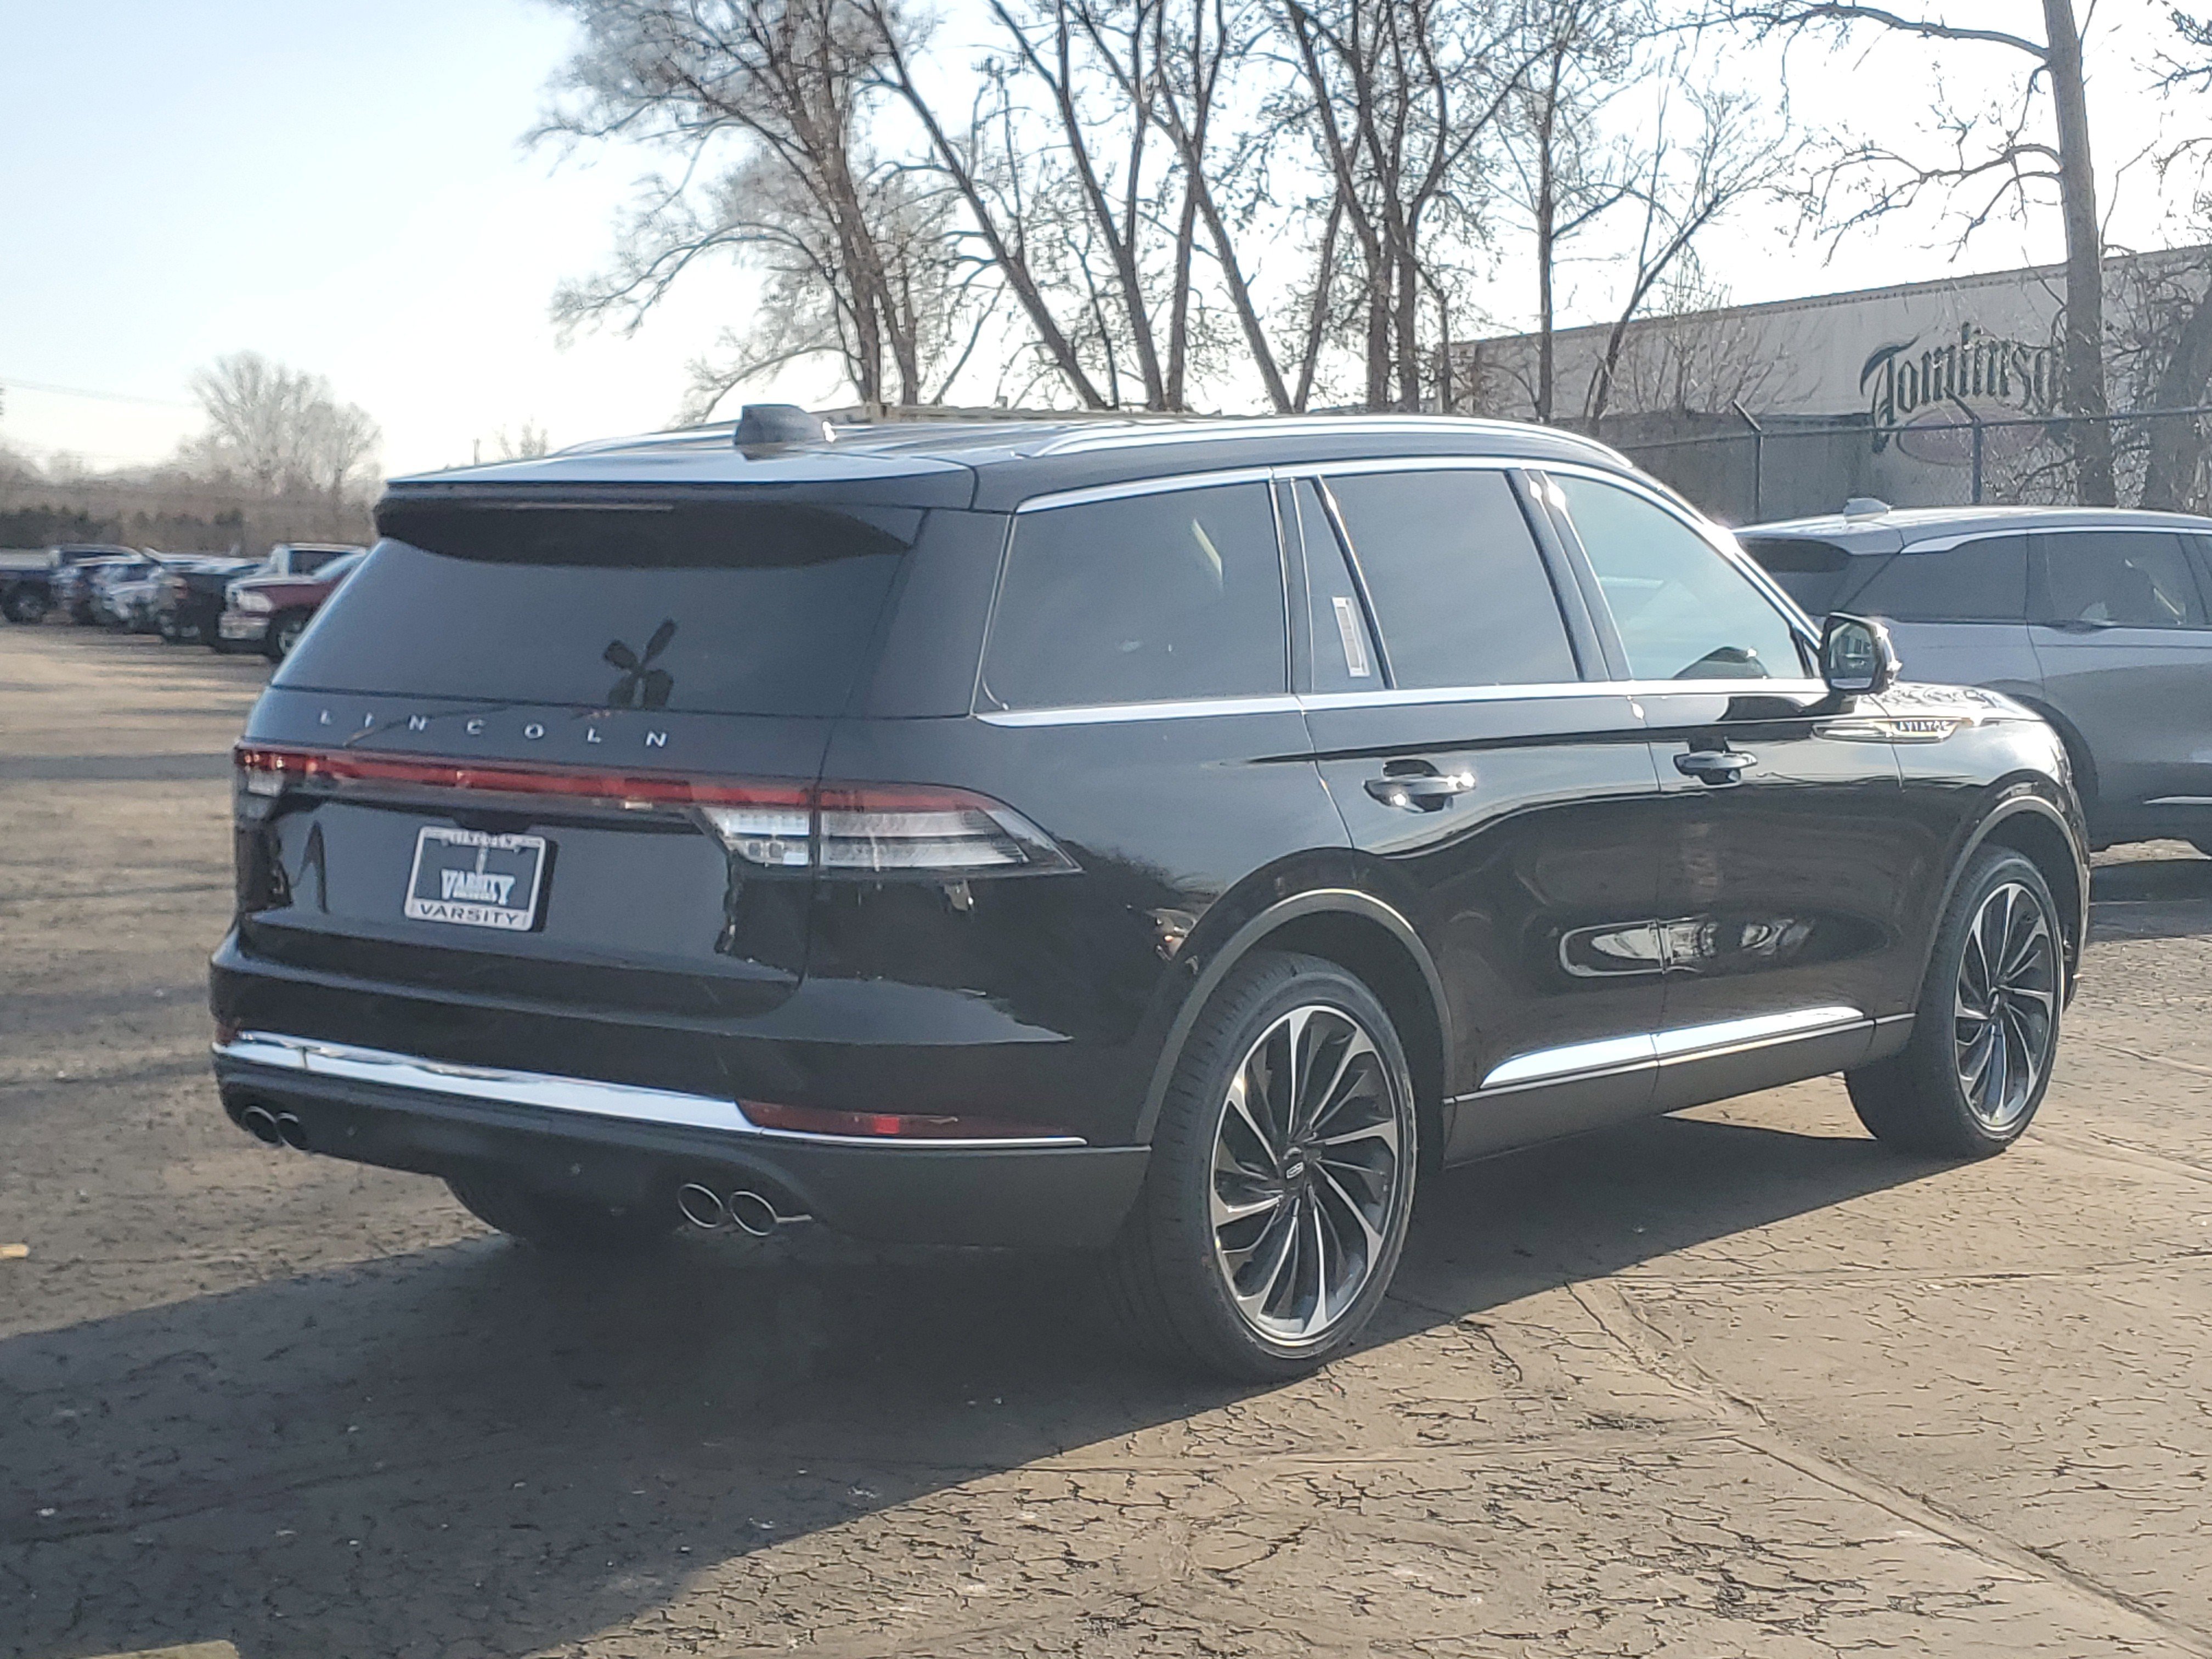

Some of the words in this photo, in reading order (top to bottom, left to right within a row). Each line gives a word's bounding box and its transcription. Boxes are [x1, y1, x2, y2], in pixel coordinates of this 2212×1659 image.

[1860, 319, 2070, 454] Tomlinso
[320, 709, 667, 748] LINCOLN
[420, 903, 520, 926] VARSITY
